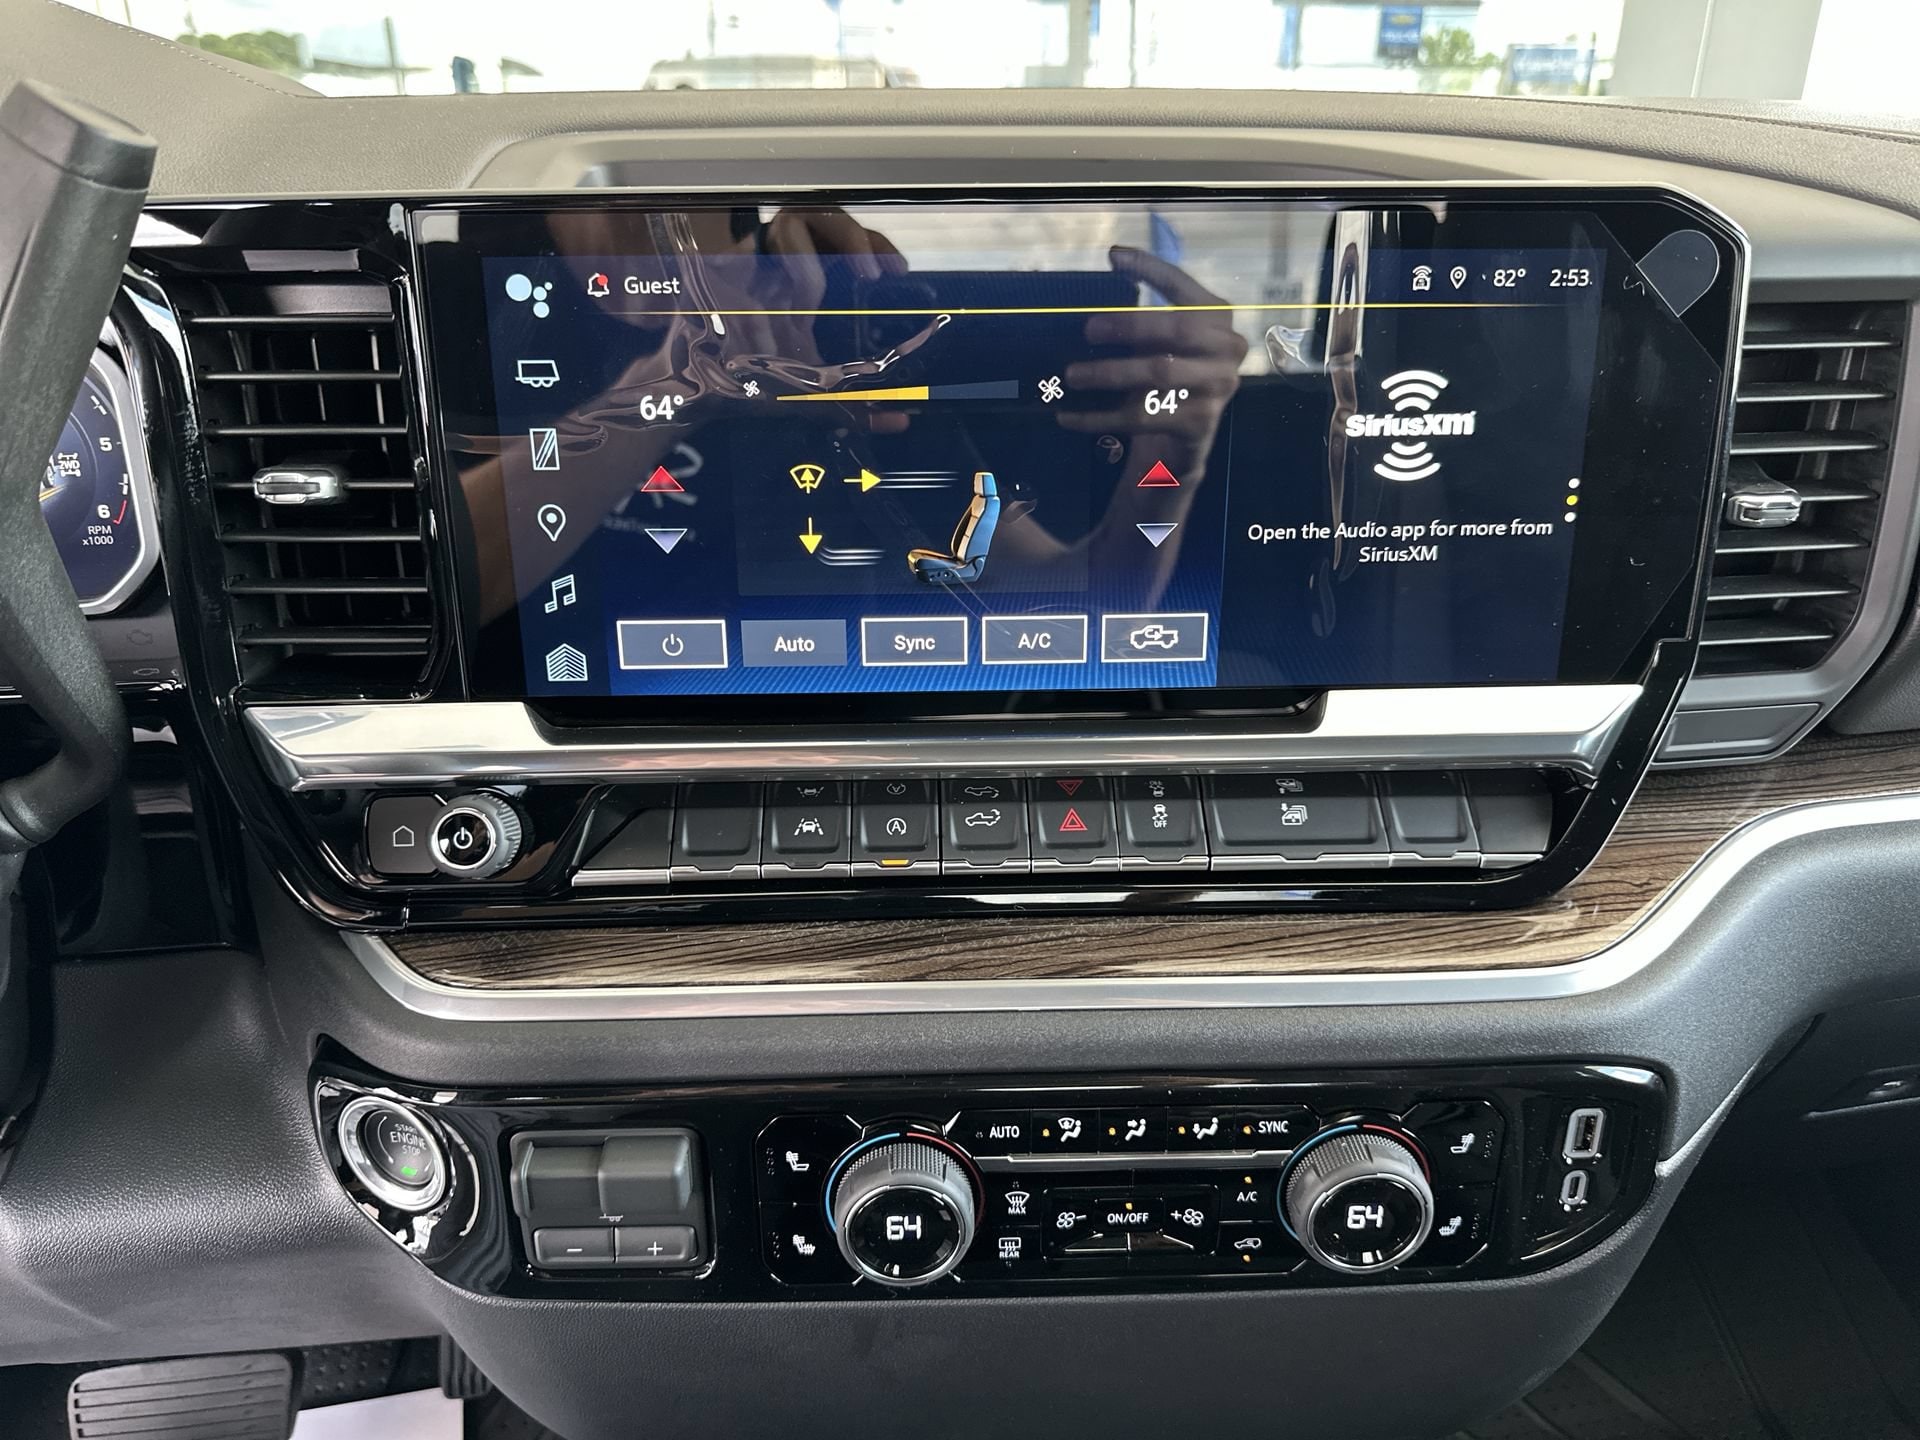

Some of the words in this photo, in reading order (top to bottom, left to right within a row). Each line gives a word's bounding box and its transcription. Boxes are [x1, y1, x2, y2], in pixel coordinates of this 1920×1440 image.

[624, 276, 680, 295] Guest
[1493, 268, 1527, 287] 82°
[1550, 268, 1589, 287] 2:53
[639, 395, 684, 420] 64°
[1144, 389, 1190, 415] 64°
[99, 437, 112, 451] 5
[97, 504, 110, 519] 6
[88, 525, 112, 535] RPM
[1247, 523, 1297, 544] Open
[1301, 522, 1331, 539] the
[1334, 521, 1387, 539] Audio
[1391, 524, 1426, 541] app
[1429, 519, 1457, 537] for
[1460, 521, 1506, 536] more
[1510, 518, 1554, 535] from
[82, 535, 114, 545] x1000
[1358, 545, 1438, 563] SiriusXM
[774, 635, 815, 653] Auto
[894, 634, 936, 653] Sync
[1018, 632, 1051, 650] A/C
[1153, 820, 1168, 828] OFF
[989, 1125, 1020, 1139] AUTO
[1258, 1120, 1289, 1134] SYNC
[390, 1131, 427, 1151] ENGINE
[401, 1144, 421, 1156] STOP
[1236, 1191, 1258, 1202] A/C
[1008, 1206, 1027, 1214] MAX
[1107, 1212, 1149, 1225] ON/OFF
[1346, 1204, 1385, 1230] 64
[886, 1214, 921, 1240] 64
[999, 1250, 1020, 1258] REAR
